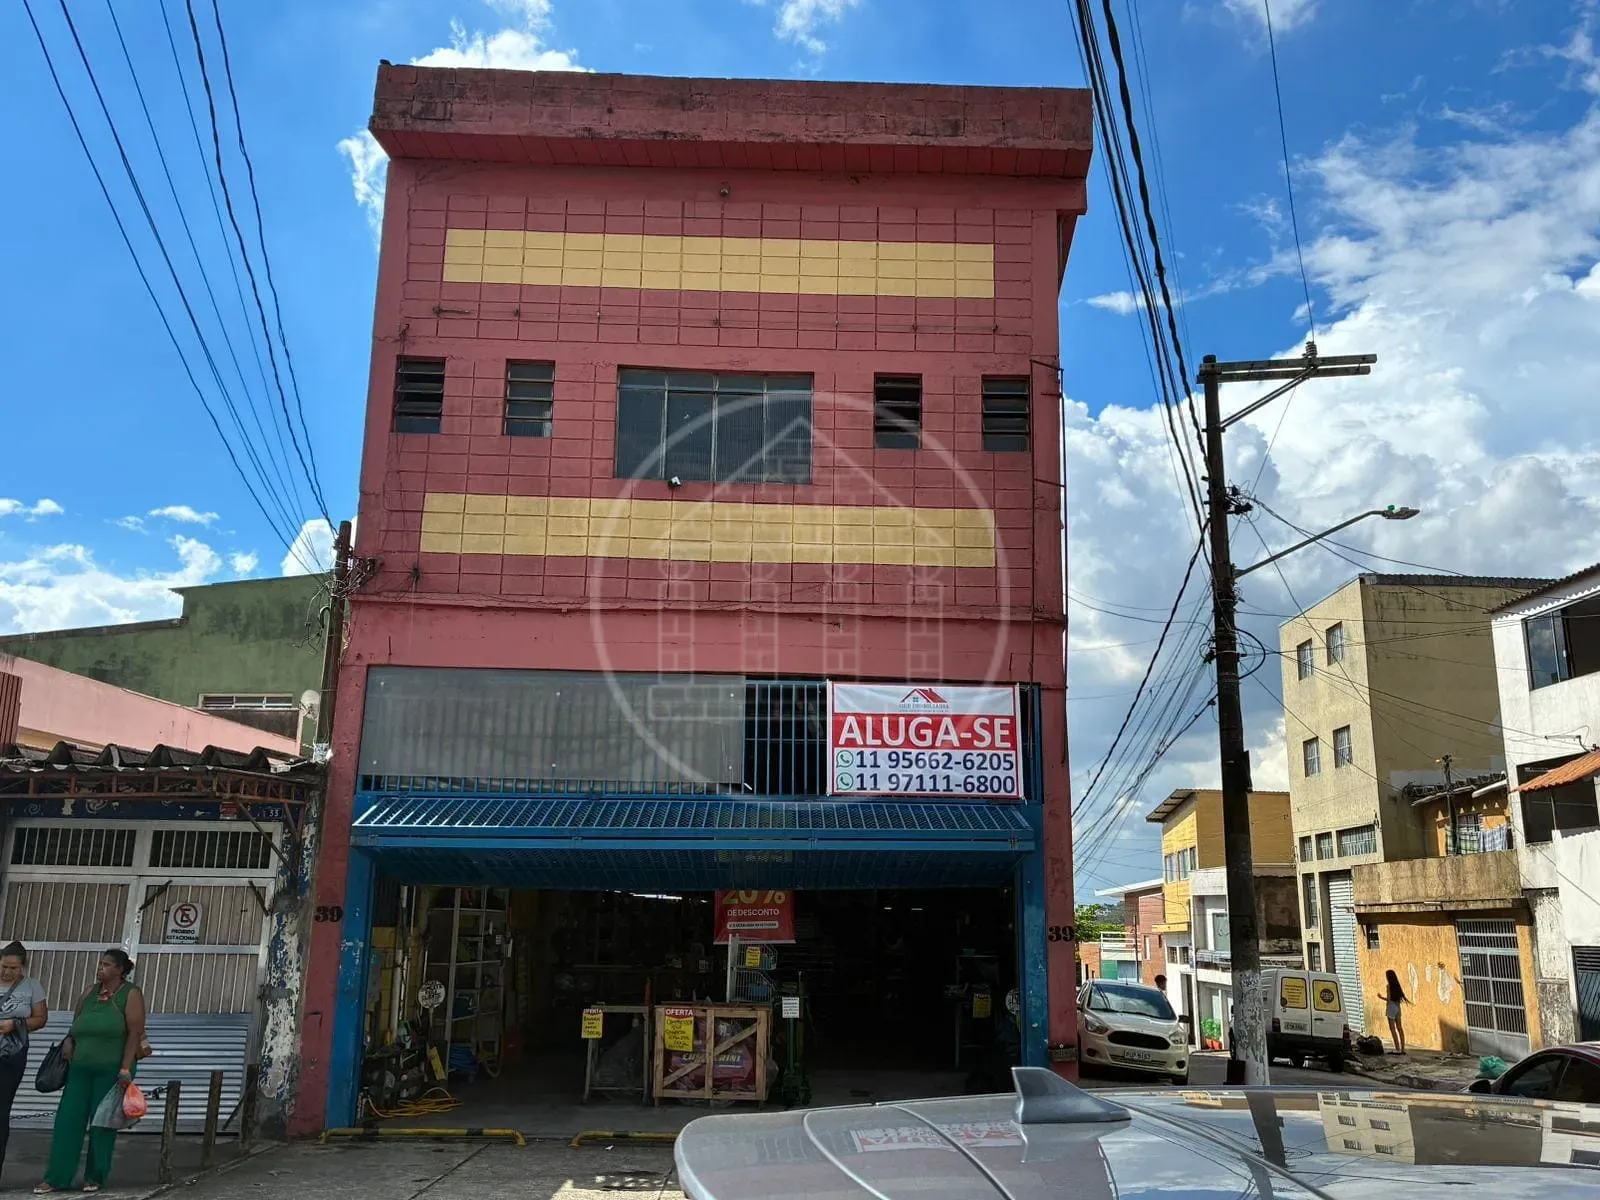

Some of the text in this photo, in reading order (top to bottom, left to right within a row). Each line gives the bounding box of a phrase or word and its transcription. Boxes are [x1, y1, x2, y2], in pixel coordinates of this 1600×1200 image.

[838, 716, 1011, 747] ALUGA-SE
[856, 750, 1014, 771] 11 95662-6205
[856, 773, 1015, 794] 11 97111-6800
[268, 809, 279, 817] 33
[314, 906, 343, 922] 39
[727, 908, 780, 917] DE DESCONTO
[1048, 926, 1074, 942] 39
[665, 1008, 694, 1016] OFERTA
